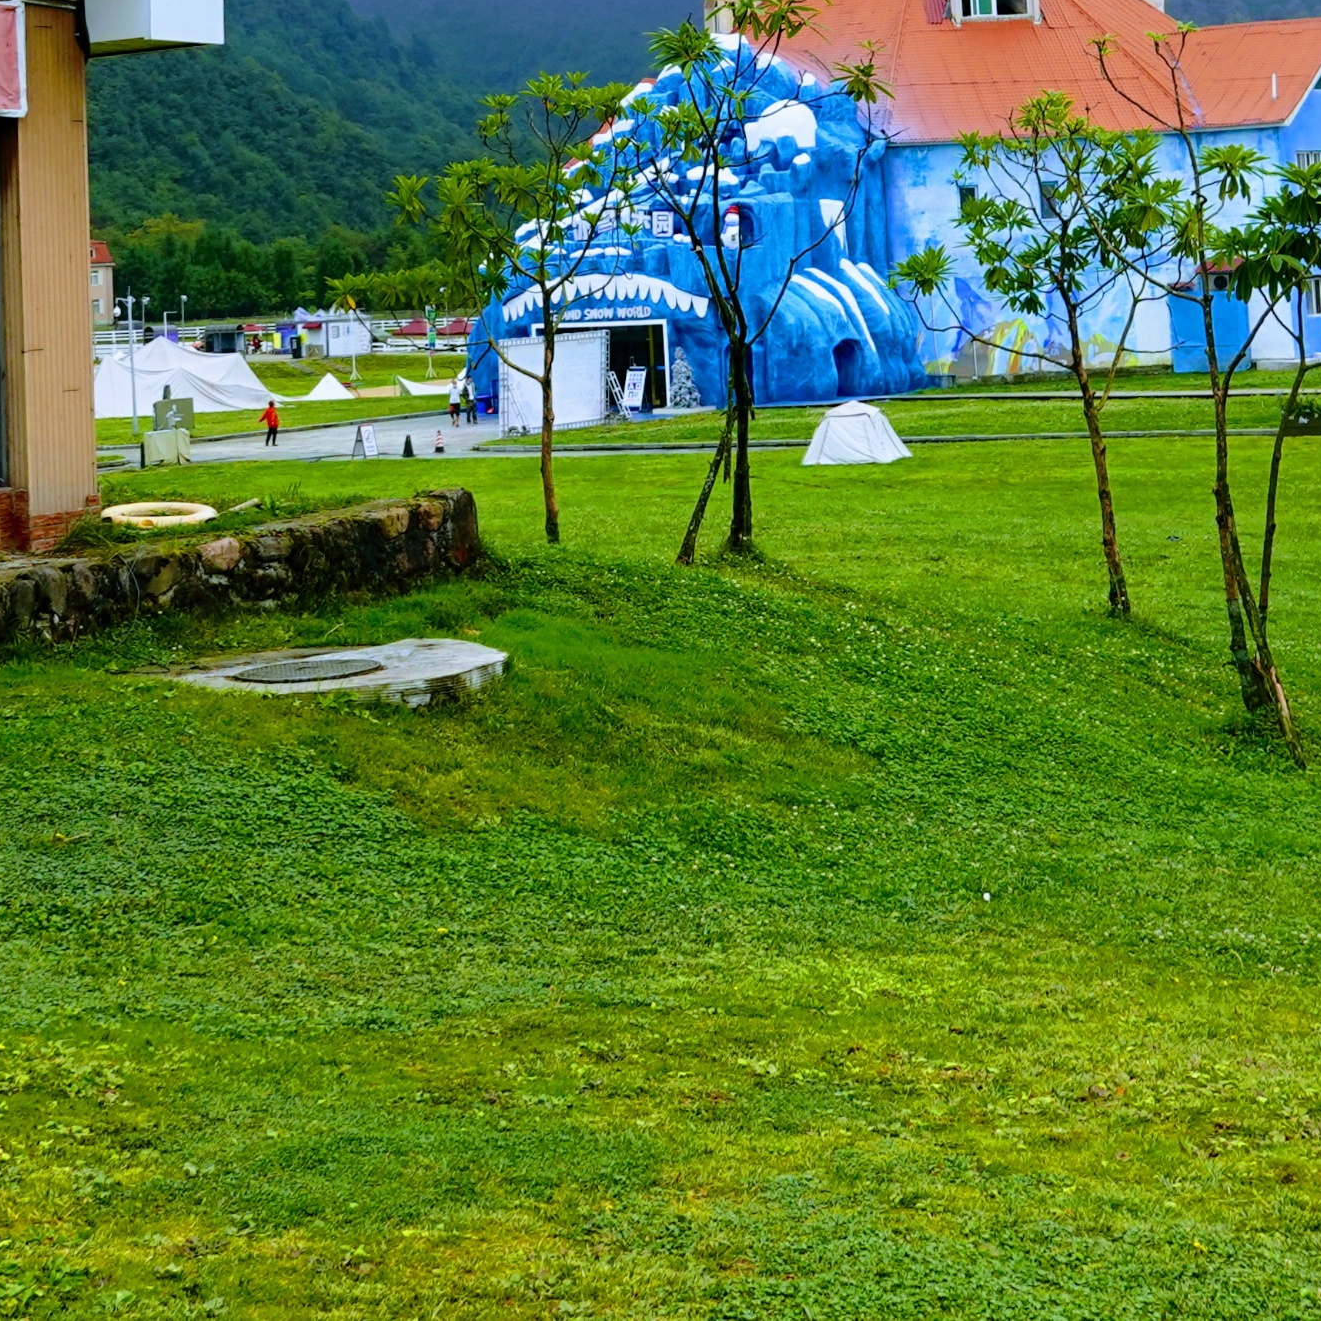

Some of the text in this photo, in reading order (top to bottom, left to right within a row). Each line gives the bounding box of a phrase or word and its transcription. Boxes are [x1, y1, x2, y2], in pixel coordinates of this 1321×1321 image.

[562, 309, 582, 321] AND
[583, 307, 614, 321] SNOW
[616, 305, 652, 319] WORLD
